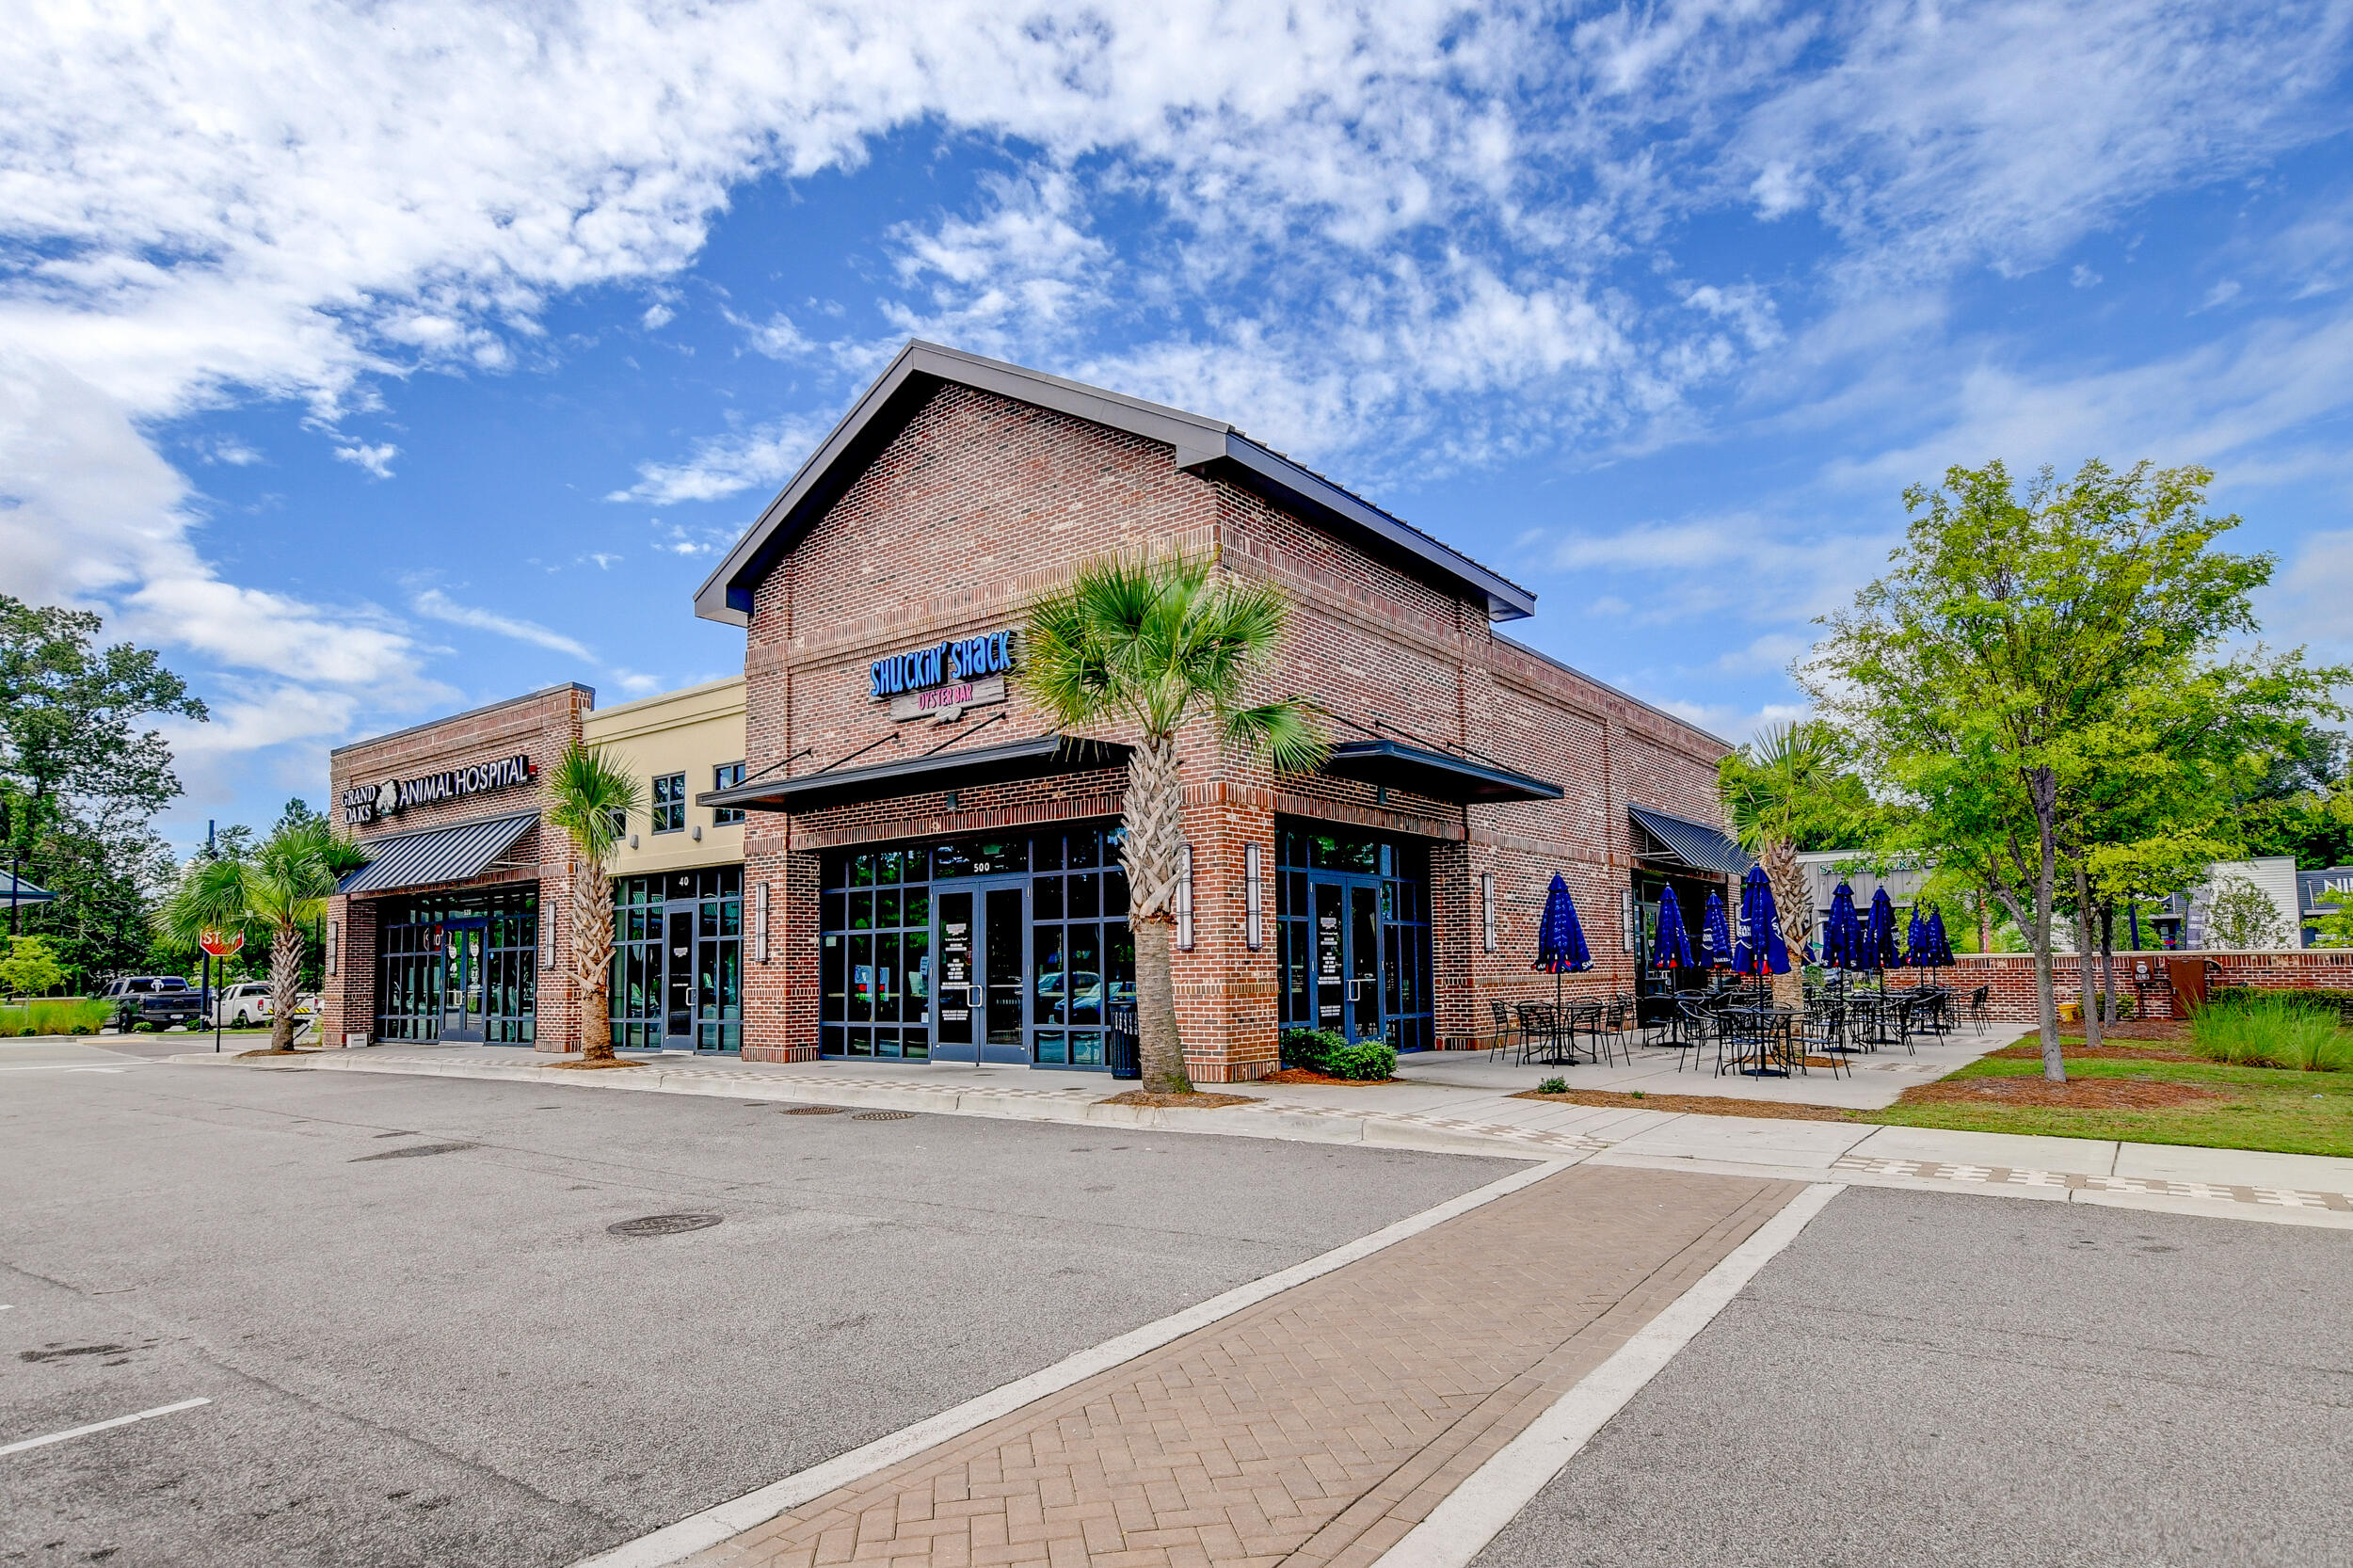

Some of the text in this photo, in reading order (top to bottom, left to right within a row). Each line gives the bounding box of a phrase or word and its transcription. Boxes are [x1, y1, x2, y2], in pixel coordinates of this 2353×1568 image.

[918, 683, 973, 711] OYSTER BAR
[399, 755, 528, 807] ANIMAL HOSPITAL
[341, 785, 376, 808] GRAND
[344, 804, 371, 824] OAKS
[973, 862, 990, 872] 500
[1818, 857, 1920, 875] STRBCKS
[679, 876, 689, 887] 40
